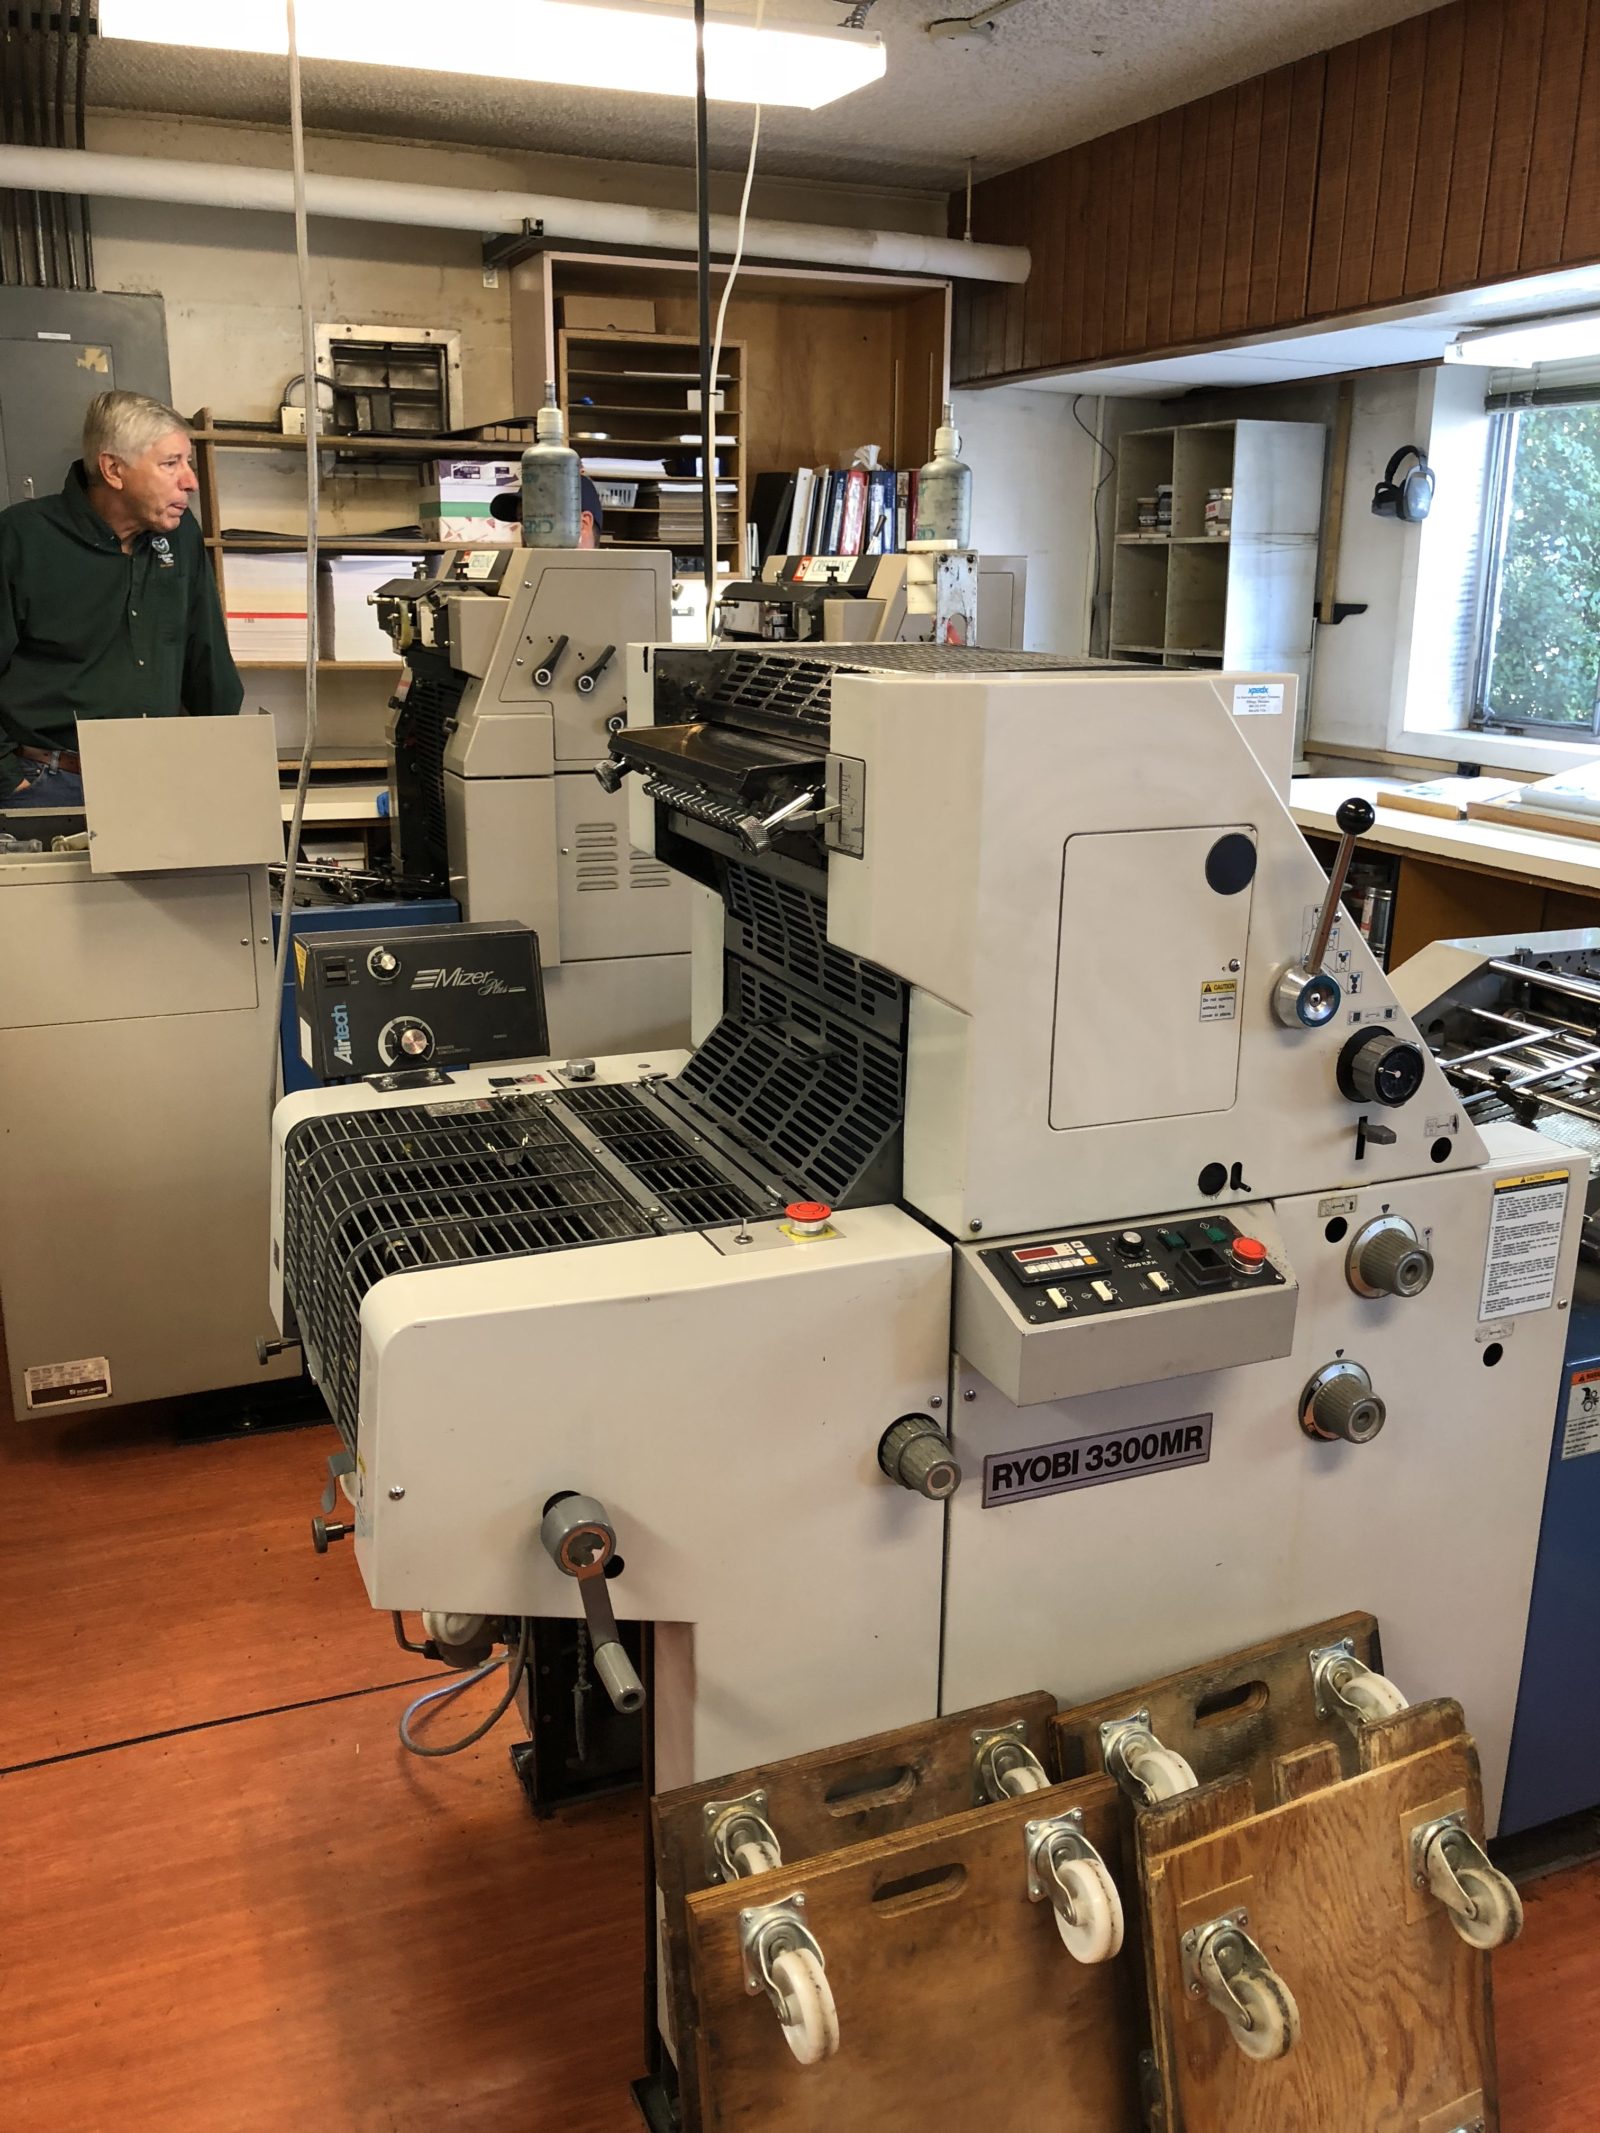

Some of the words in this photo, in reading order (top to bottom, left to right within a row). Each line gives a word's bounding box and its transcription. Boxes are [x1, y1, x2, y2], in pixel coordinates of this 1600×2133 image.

[478, 978, 508, 995] Plus
[331, 1004, 353, 1065] Airtech
[992, 1449, 1079, 1491] RYOBI
[1085, 1425, 1203, 1471] 3300MR
